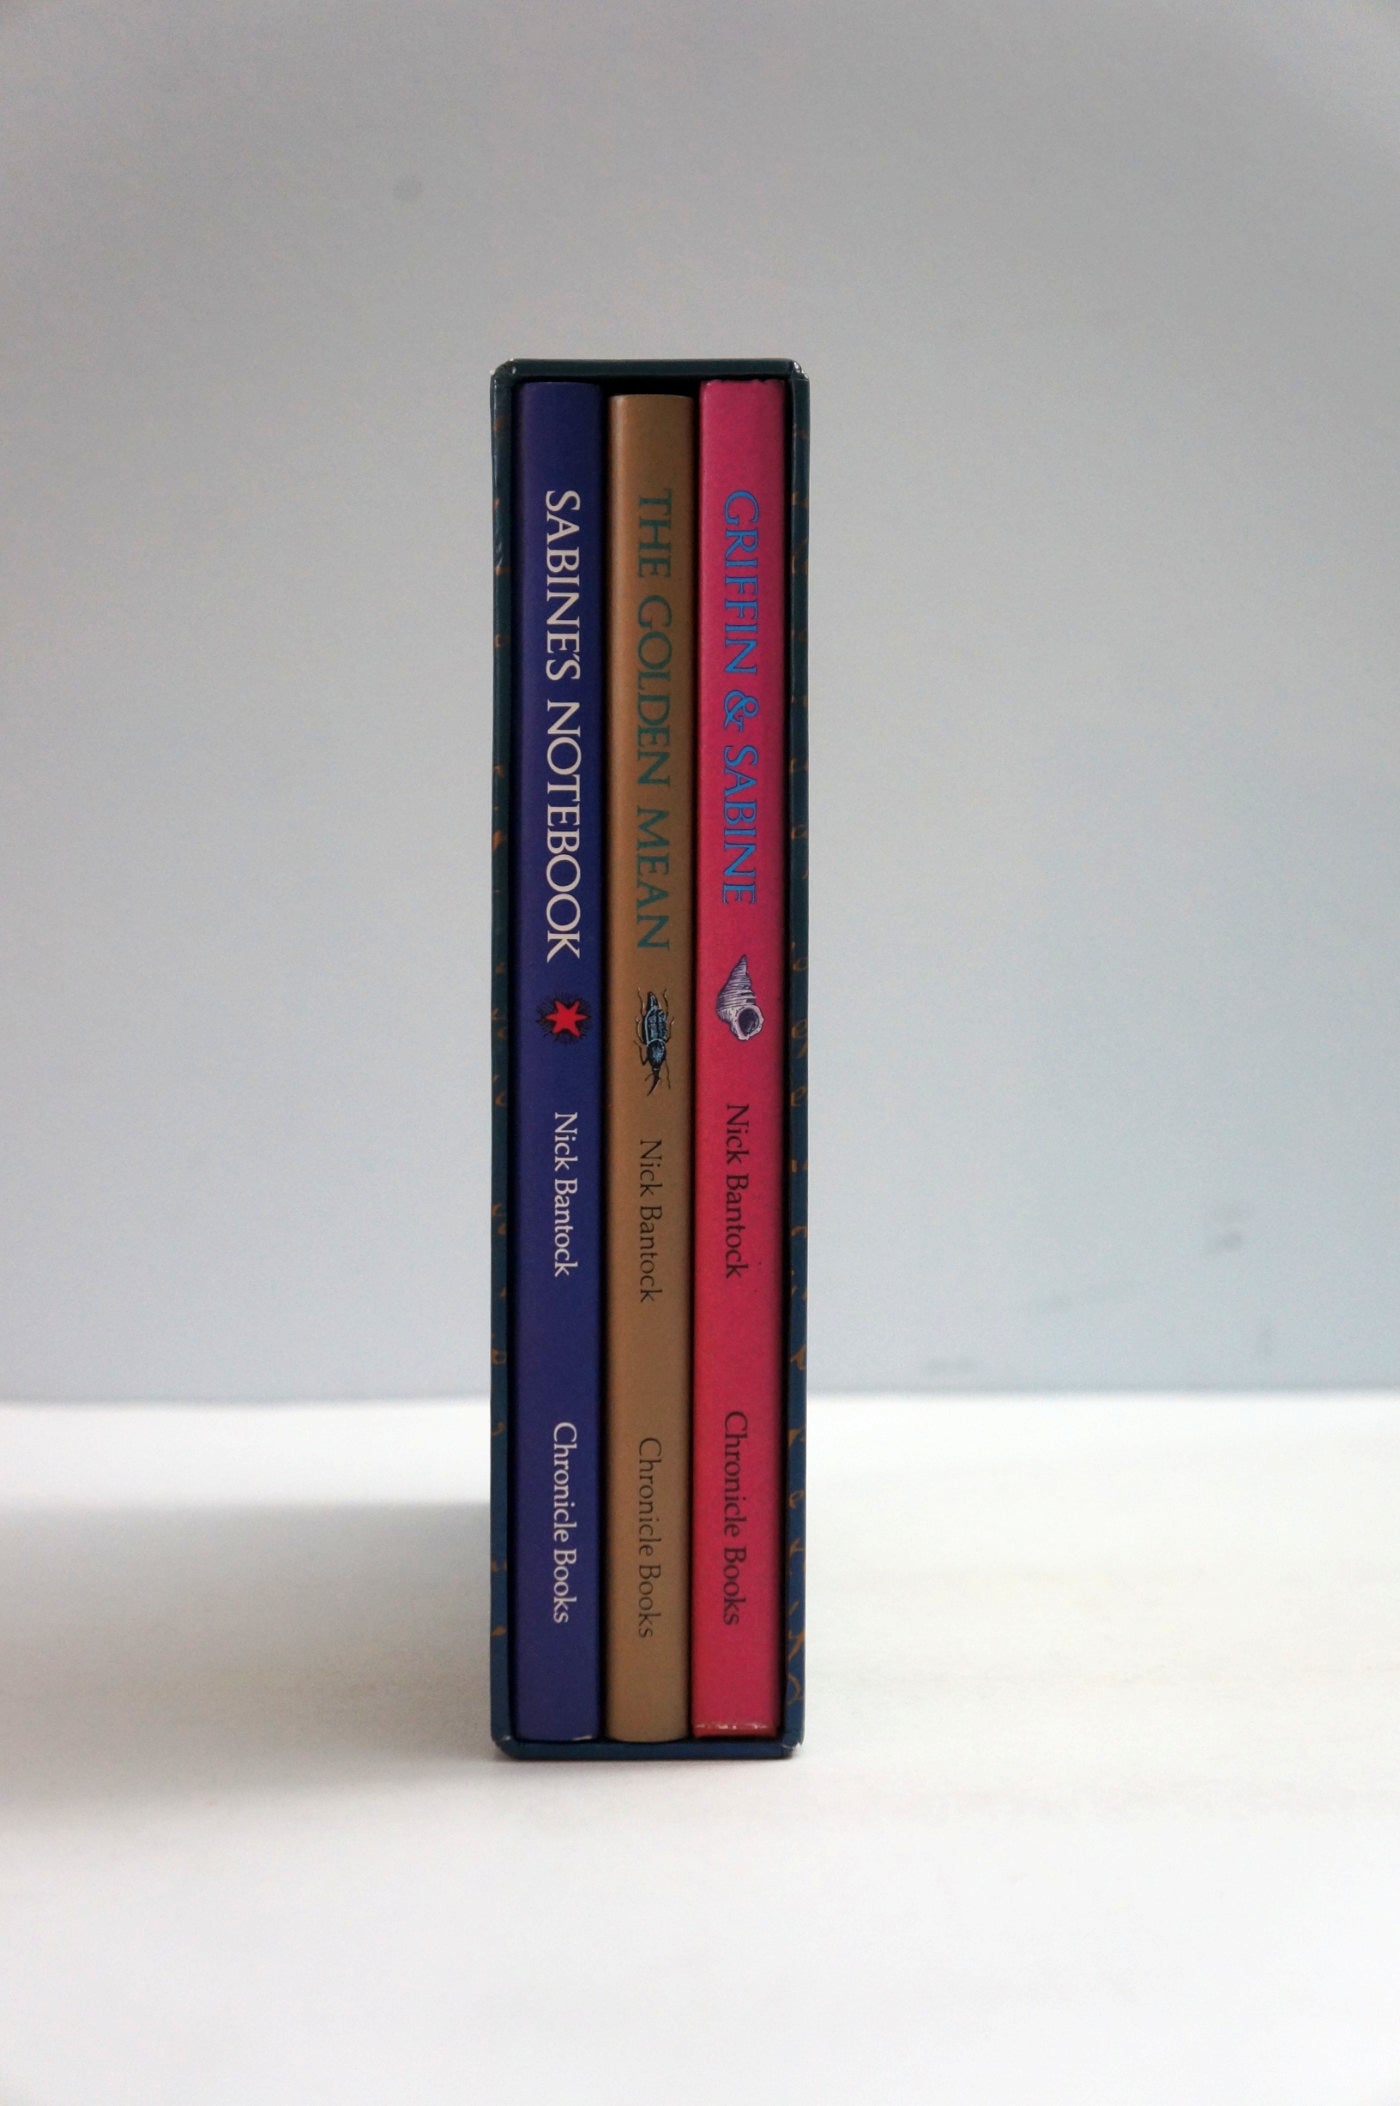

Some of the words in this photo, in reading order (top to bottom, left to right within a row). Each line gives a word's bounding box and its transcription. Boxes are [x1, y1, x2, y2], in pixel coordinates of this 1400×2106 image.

[637, 487, 672, 578] THE
[723, 489, 761, 675] GRIFFIN
[545, 489, 581, 682] SABINE'S
[636, 596, 673, 788] GOLDEN
[723, 689, 760, 733] &
[546, 699, 582, 963] NOTEBOOK
[722, 744, 760, 905] SABINE
[636, 806, 671, 951] MEAN
[553, 1111, 579, 1172] Nick
[639, 1138, 664, 1198] Nick
[725, 1103, 751, 1166] Nick
[553, 1177, 579, 1278] Bantock
[638, 1204, 664, 1304] Bantock
[725, 1173, 750, 1280] Bantock
[552, 1421, 578, 1543] Chronicle
[637, 1436, 663, 1557] Chronicle
[722, 1409, 749, 1539] Chronicle
[552, 1548, 578, 1624] Books
[637, 1563, 662, 1639] Books
[722, 1545, 748, 1626] Books
